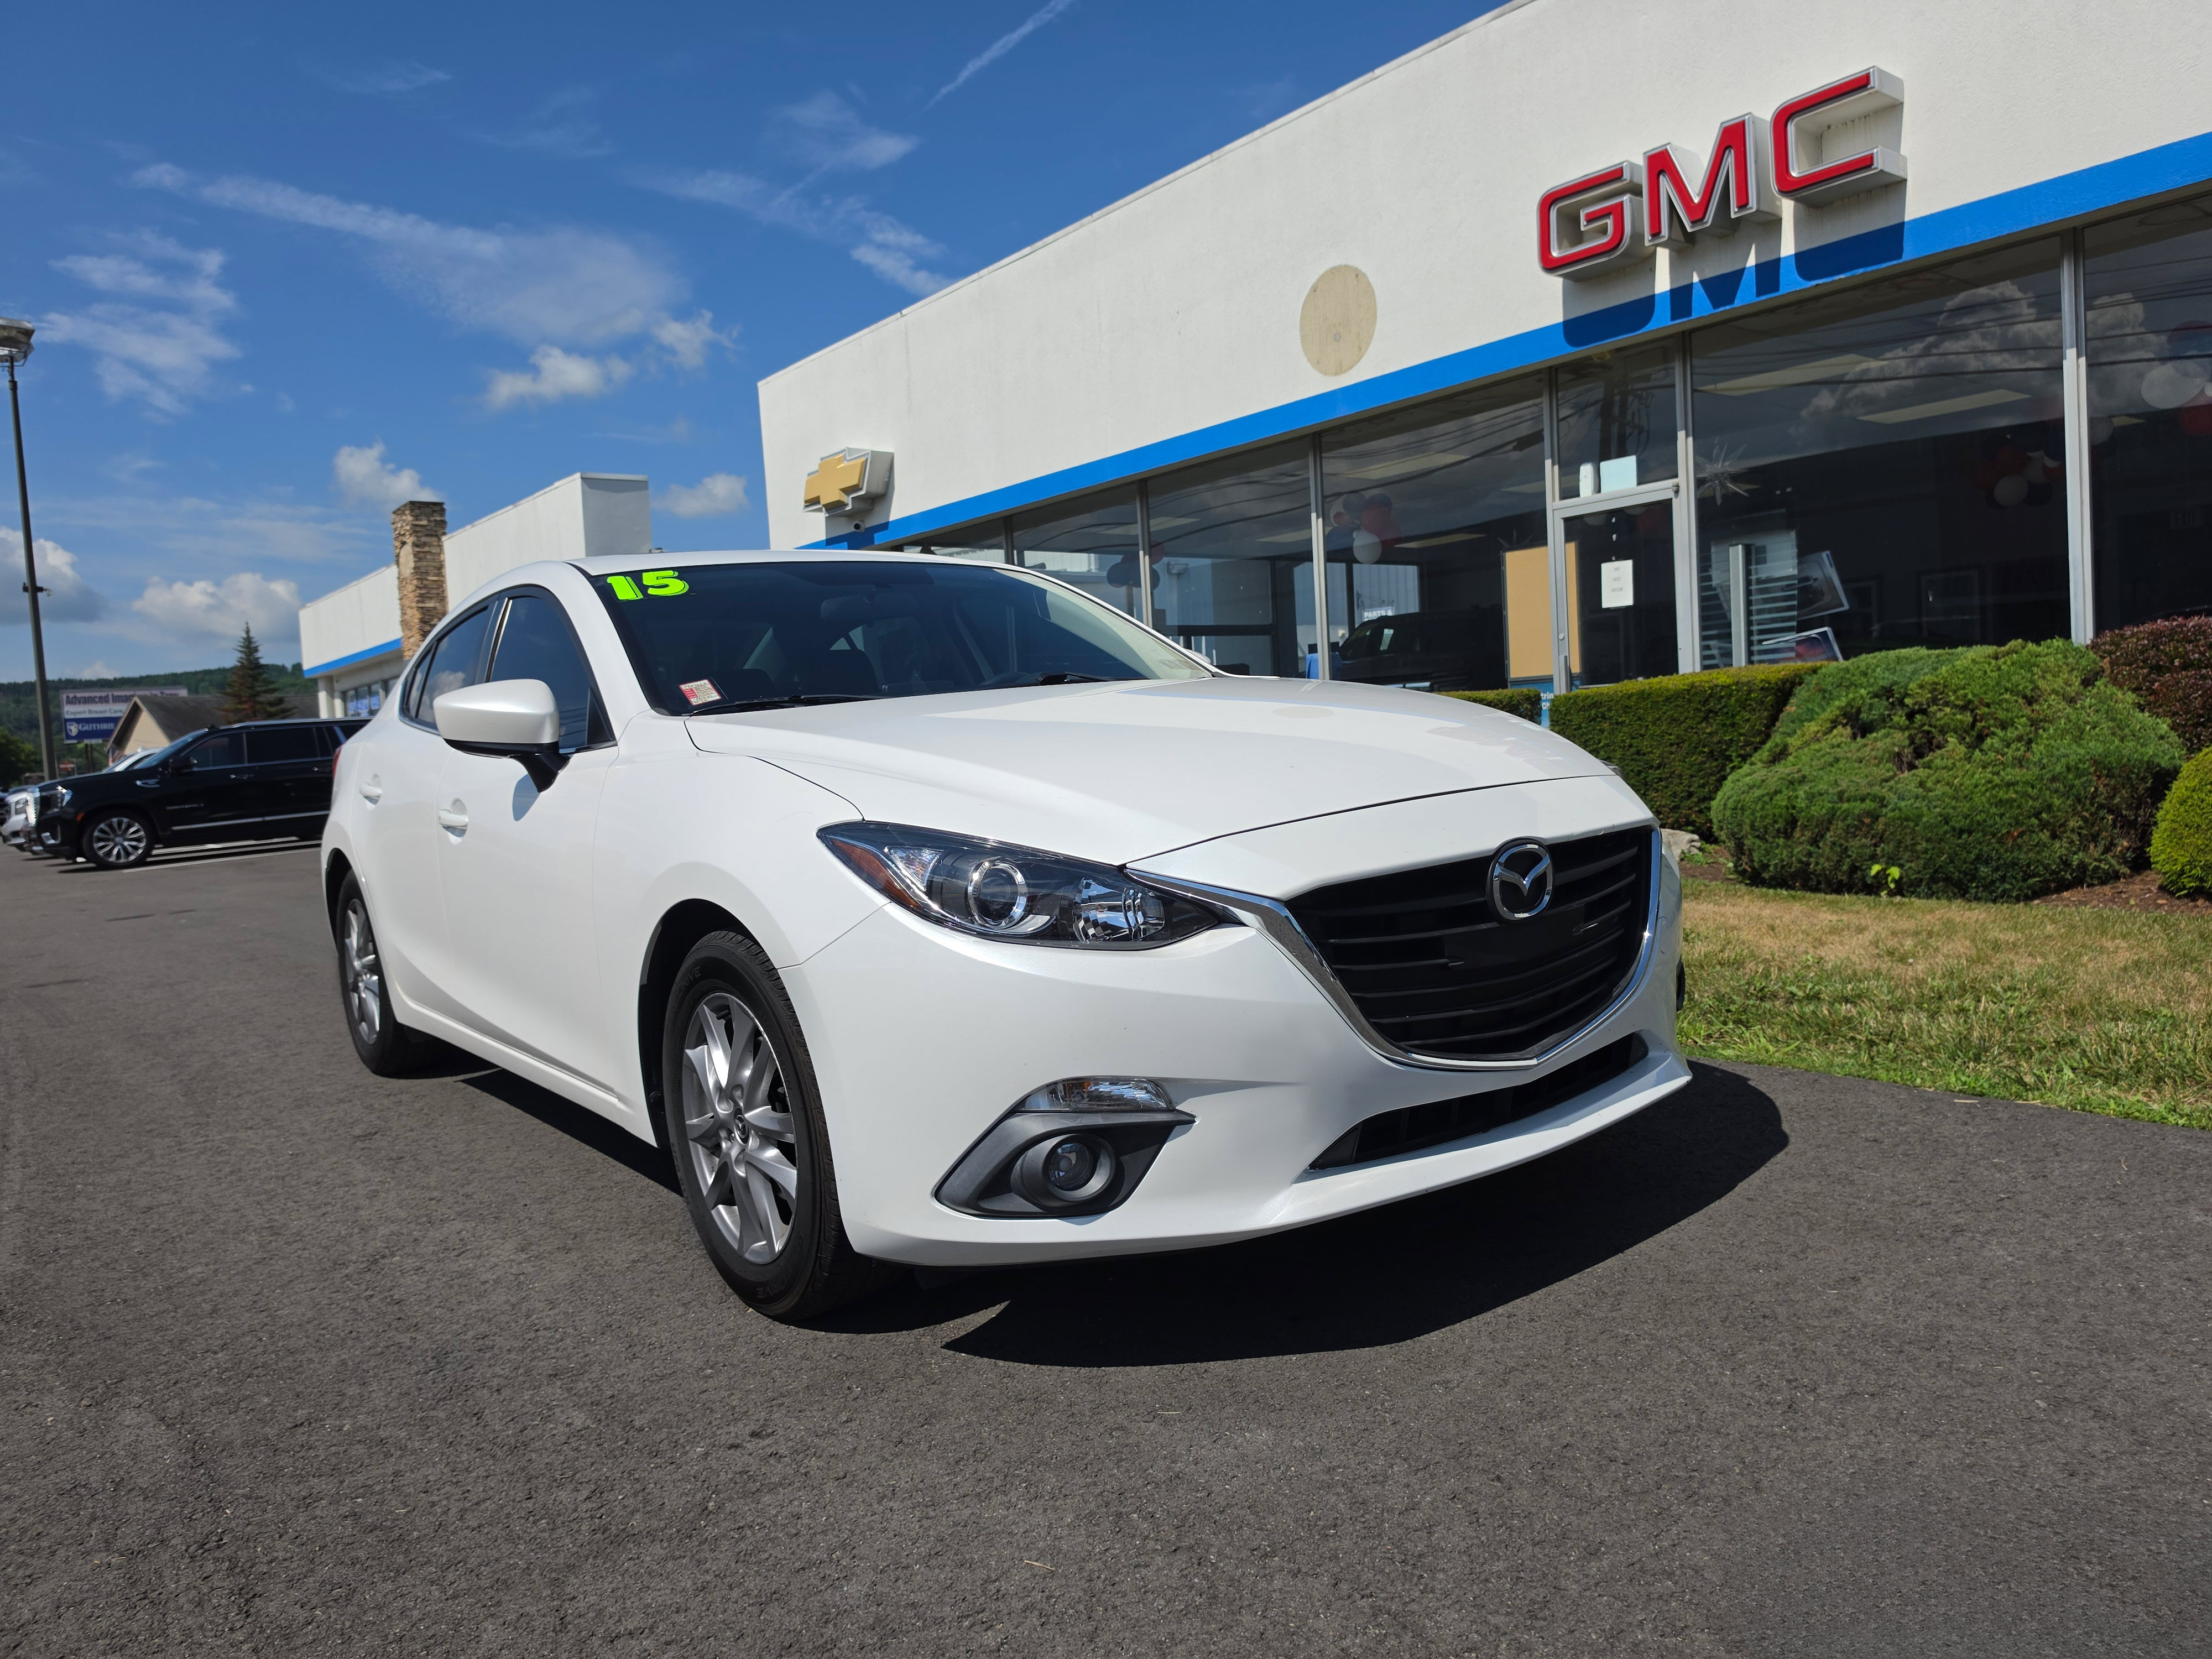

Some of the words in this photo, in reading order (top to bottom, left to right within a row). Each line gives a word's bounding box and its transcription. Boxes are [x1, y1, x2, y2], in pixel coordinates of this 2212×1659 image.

[1537, 66, 1880, 275] GMC
[607, 570, 689, 600] 15
[1364, 610, 1386, 618] PARTS
[66, 693, 109, 705] Advanced
[79, 722, 116, 731] GUTHRIE
